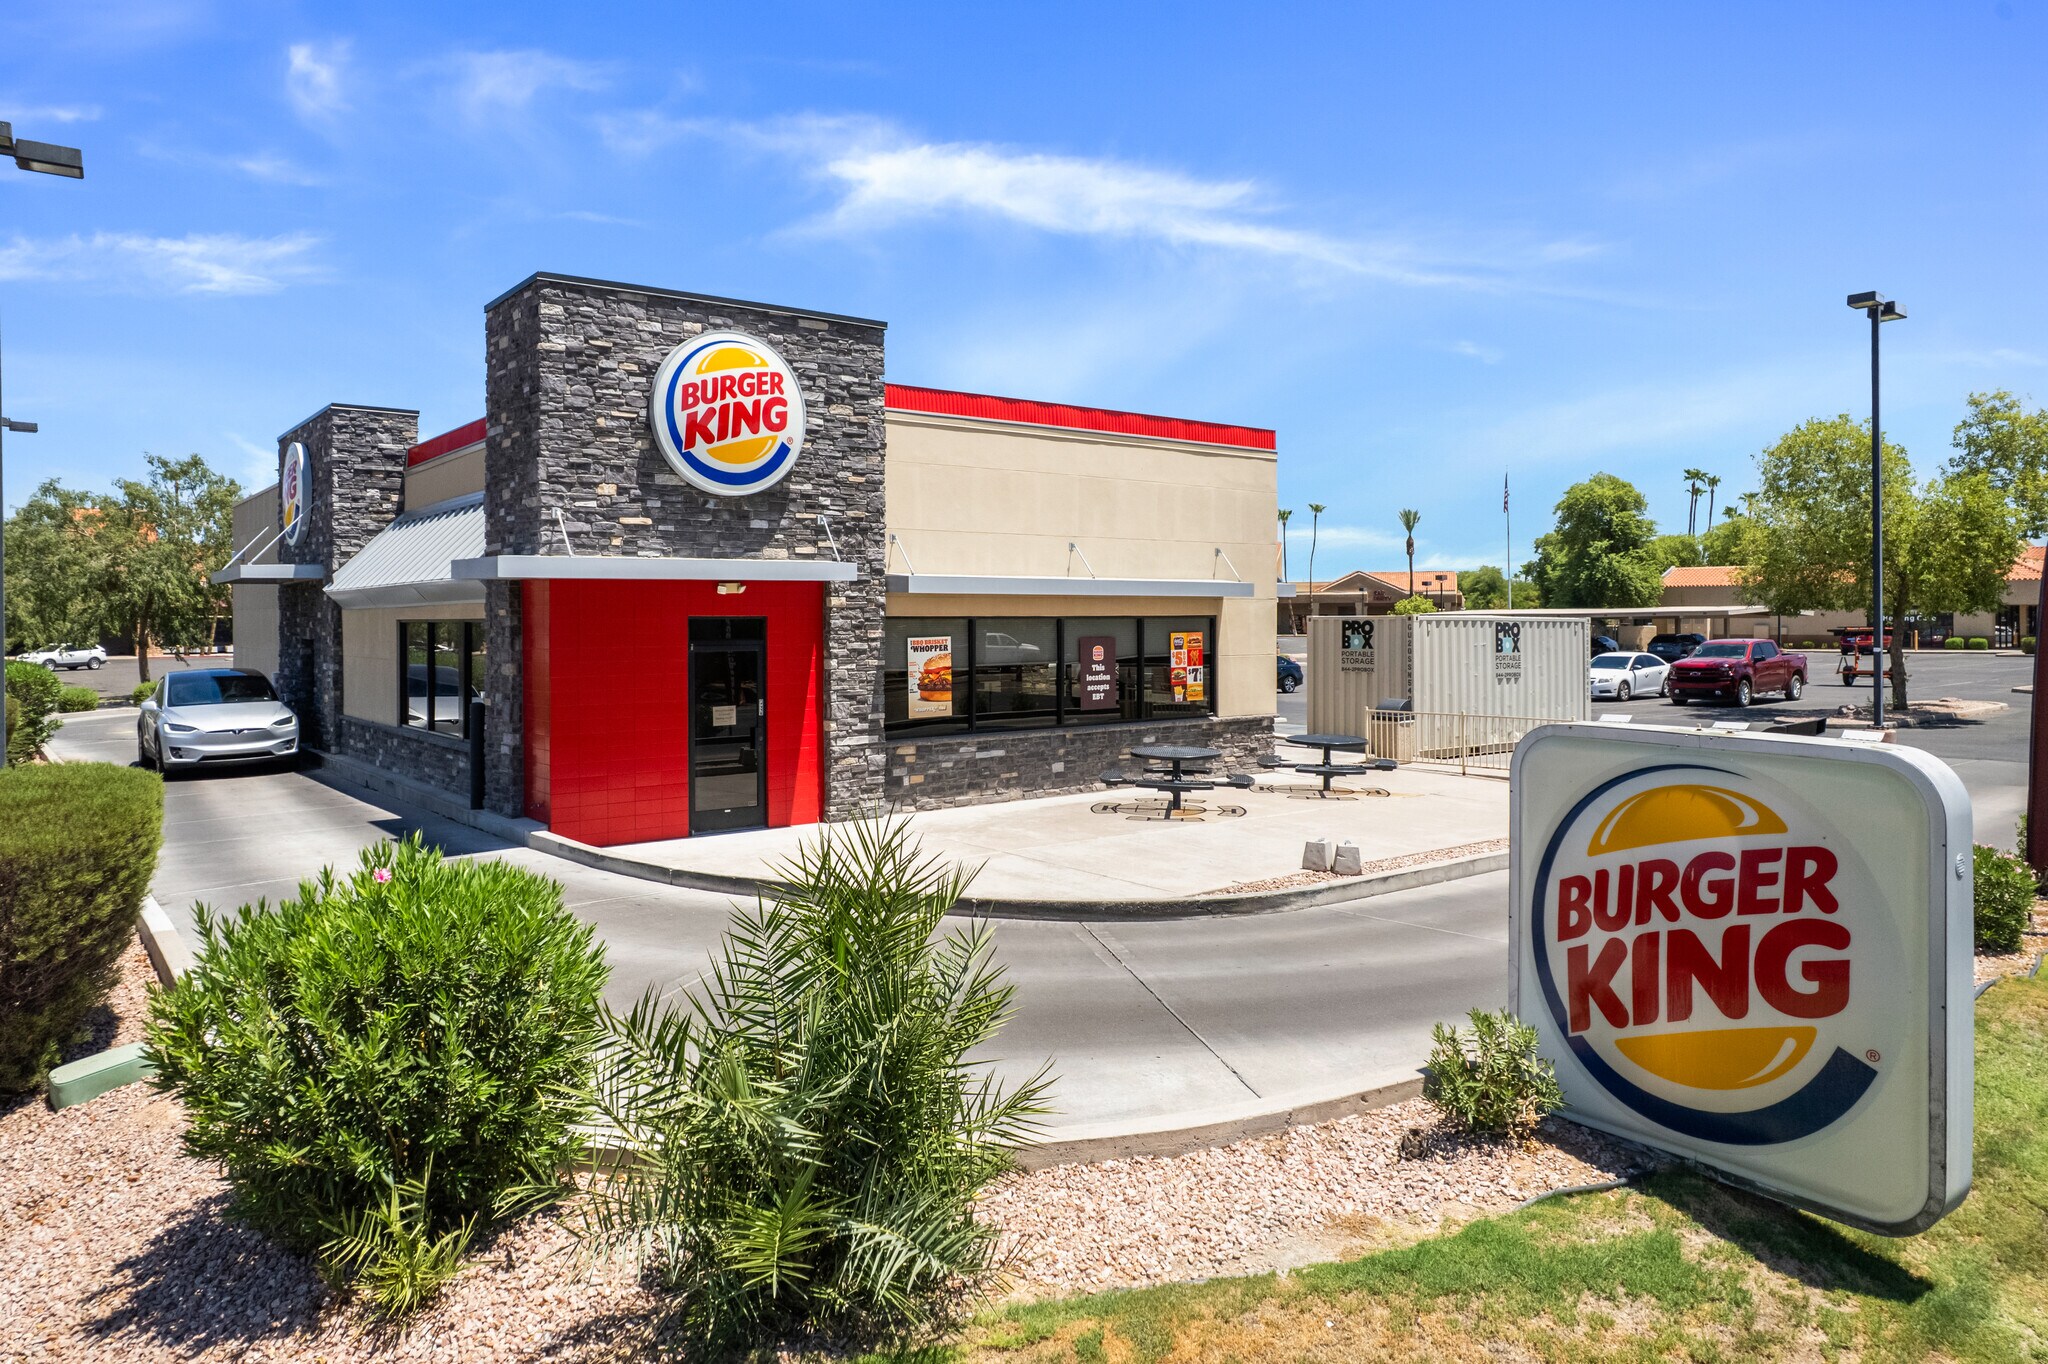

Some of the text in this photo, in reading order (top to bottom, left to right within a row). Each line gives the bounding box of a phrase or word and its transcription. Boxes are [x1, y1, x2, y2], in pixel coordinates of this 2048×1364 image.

[681, 371, 785, 412] BURGER
[683, 396, 788, 451] KING
[1342, 620, 1374, 635] PRO
[1495, 622, 1521, 638] PRO
[911, 644, 949, 652] WHOPPER
[1342, 635, 1374, 649] BOX
[1495, 637, 1521, 653] BOX
[1171, 651, 1183, 666] $5
[1341, 650, 1374, 658] PORTABLE
[1086, 673, 1110, 681] location
[1188, 667, 1199, 682] $7
[1087, 683, 1109, 692] accepts
[1557, 845, 1839, 943] BURGER
[1566, 918, 1851, 1034] KING
